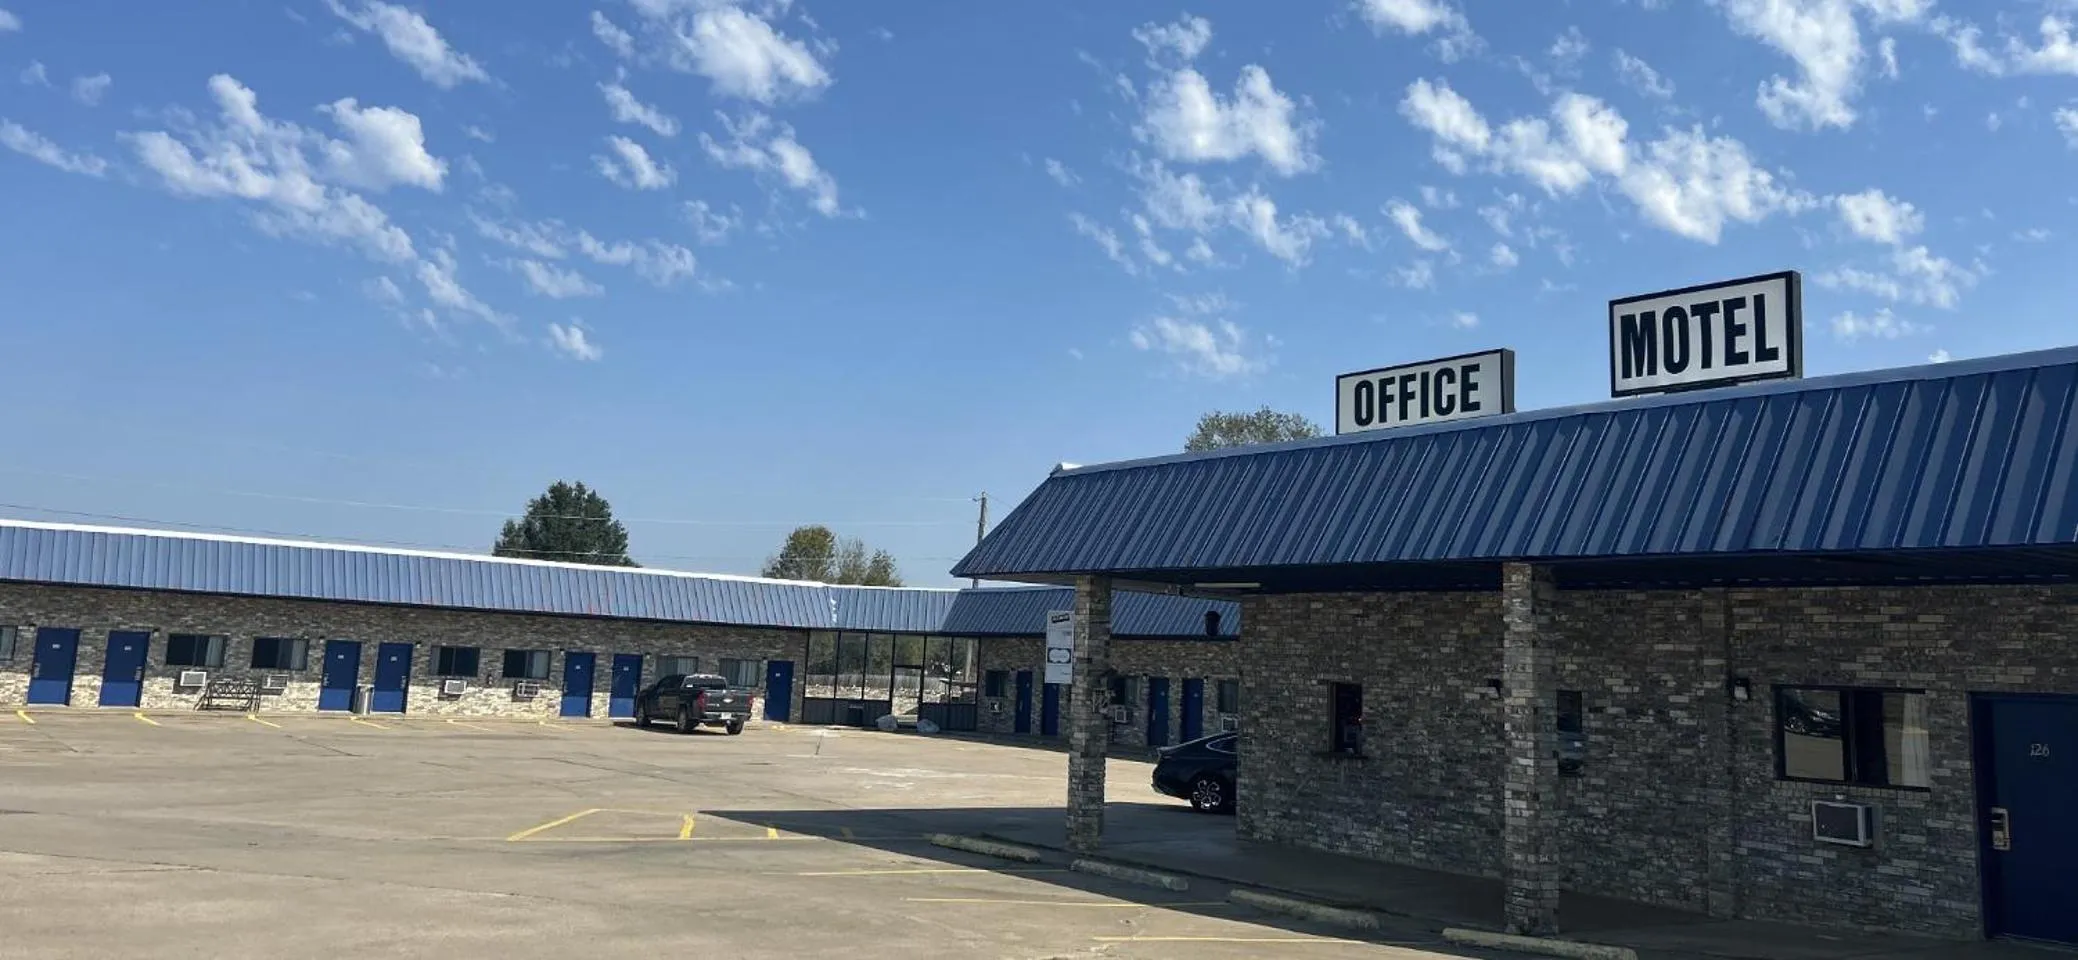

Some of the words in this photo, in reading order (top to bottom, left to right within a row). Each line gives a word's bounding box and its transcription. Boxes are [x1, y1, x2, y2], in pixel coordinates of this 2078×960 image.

[1620, 293, 1780, 380] MOTEL
[1353, 363, 1481, 427] OFFICE
[2030, 743, 2050, 757] 126
